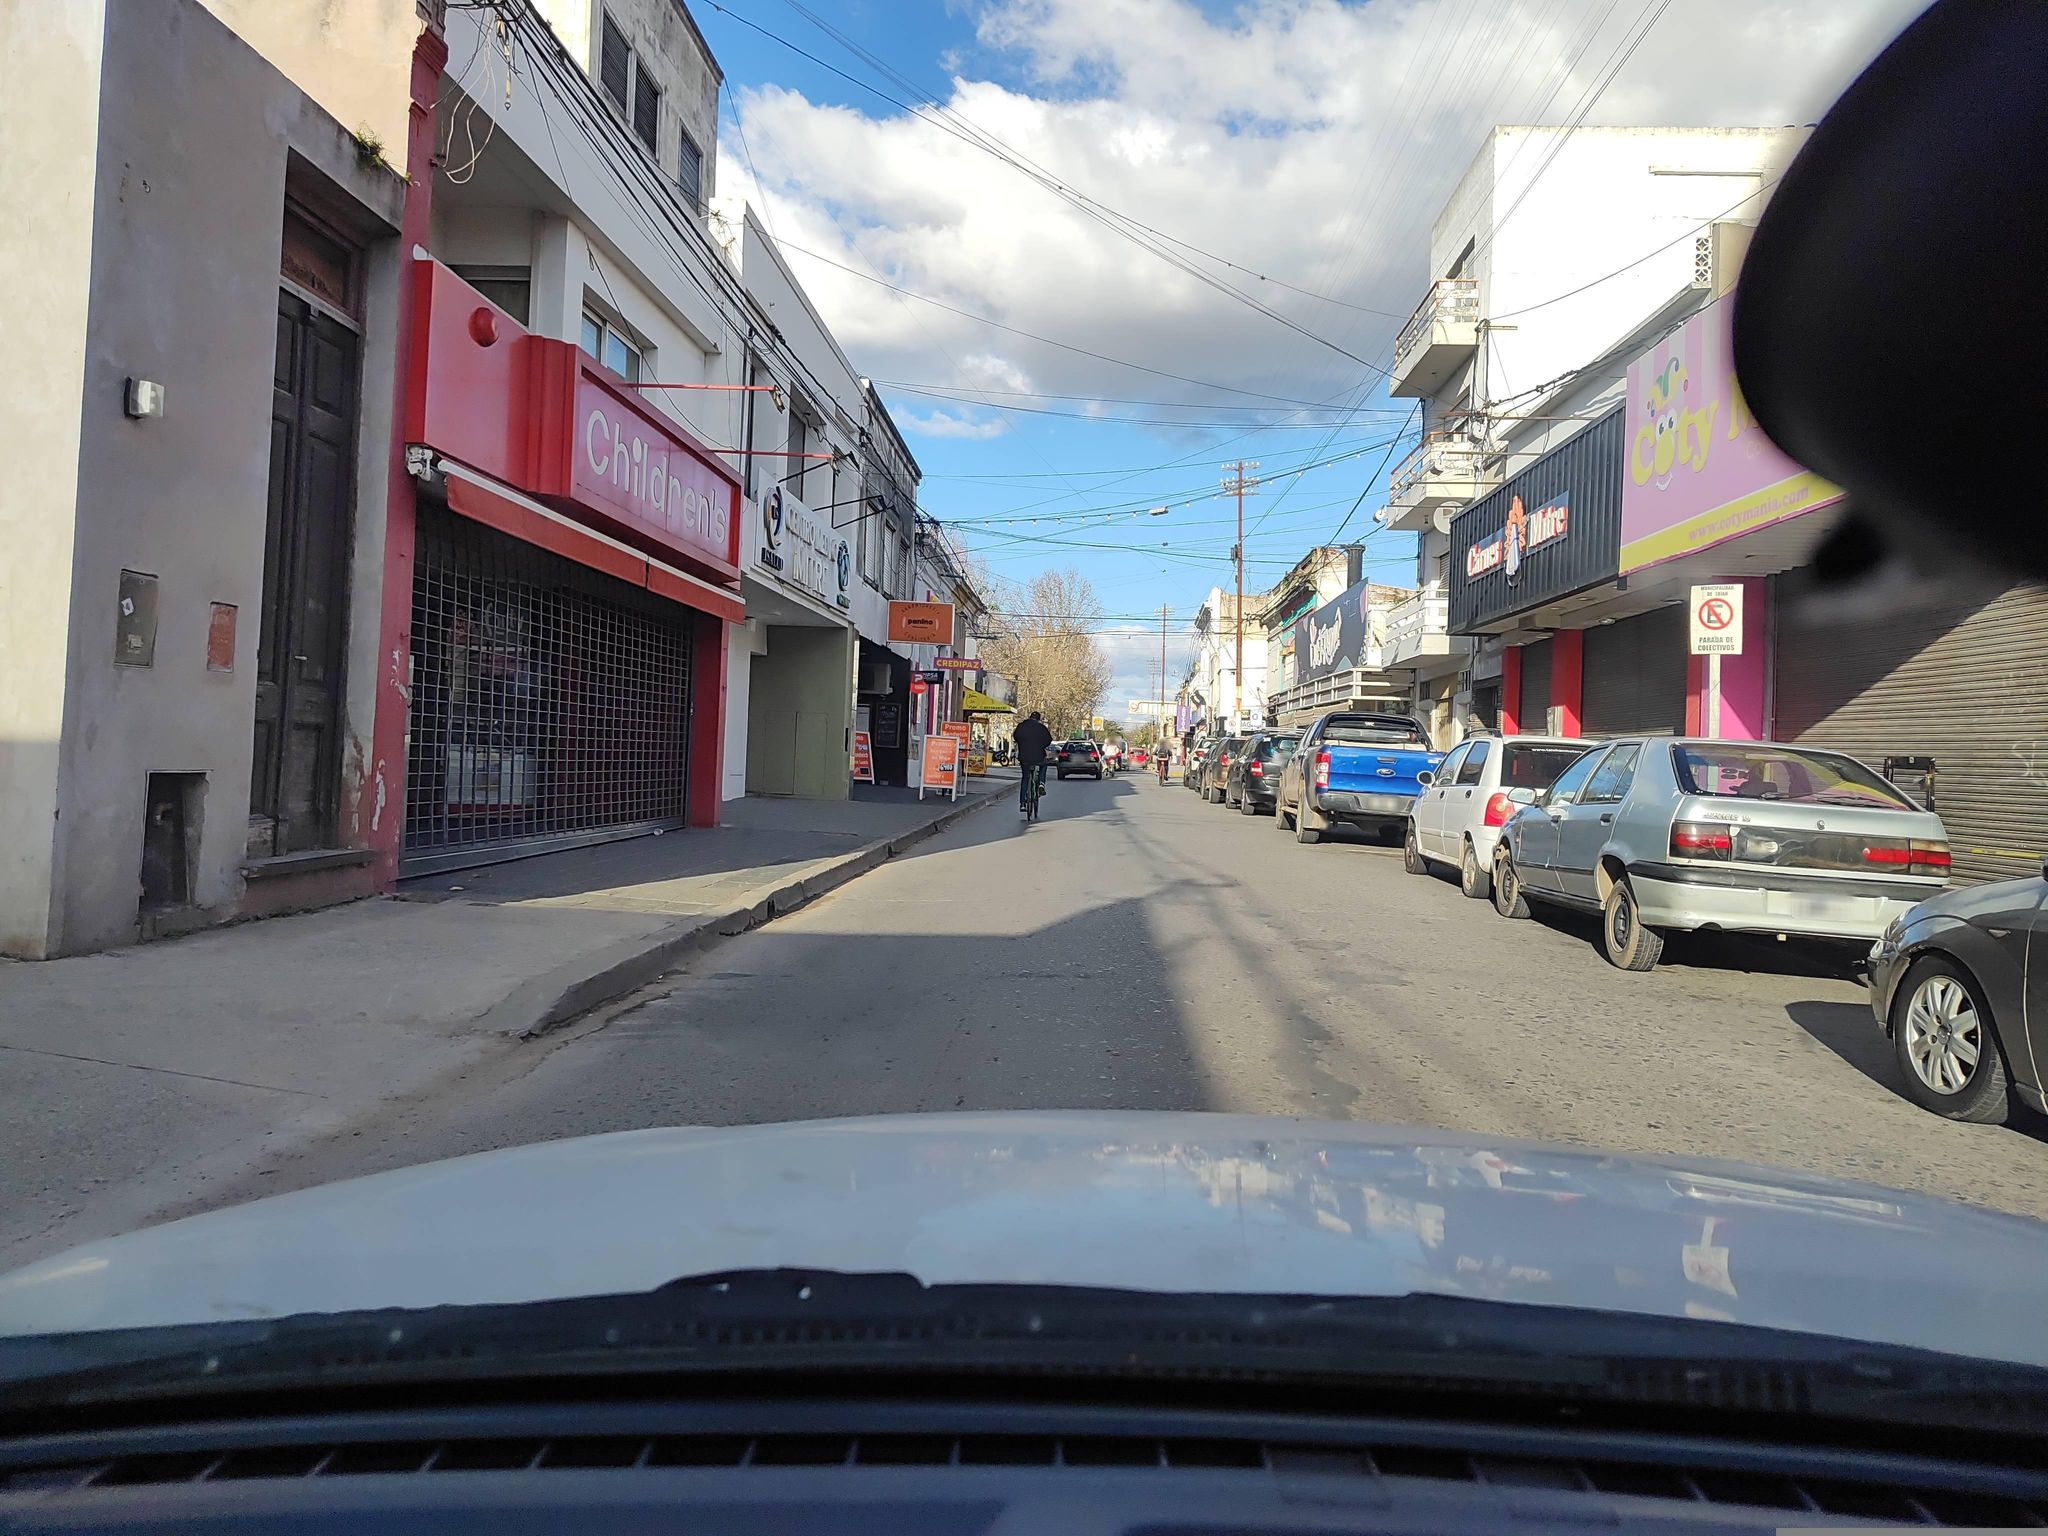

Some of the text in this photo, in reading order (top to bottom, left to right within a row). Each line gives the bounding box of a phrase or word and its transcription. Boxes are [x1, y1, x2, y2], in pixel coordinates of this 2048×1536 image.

[1631, 400, 1719, 487] Coty
[586, 409, 727, 545] Children's
[1467, 505, 1568, 578] Carnes Mitre
[1688, 487, 1809, 542] www.cotymania.com
[936, 659, 980, 669] CREDIPAZ
[944, 724, 967, 732] Promo
